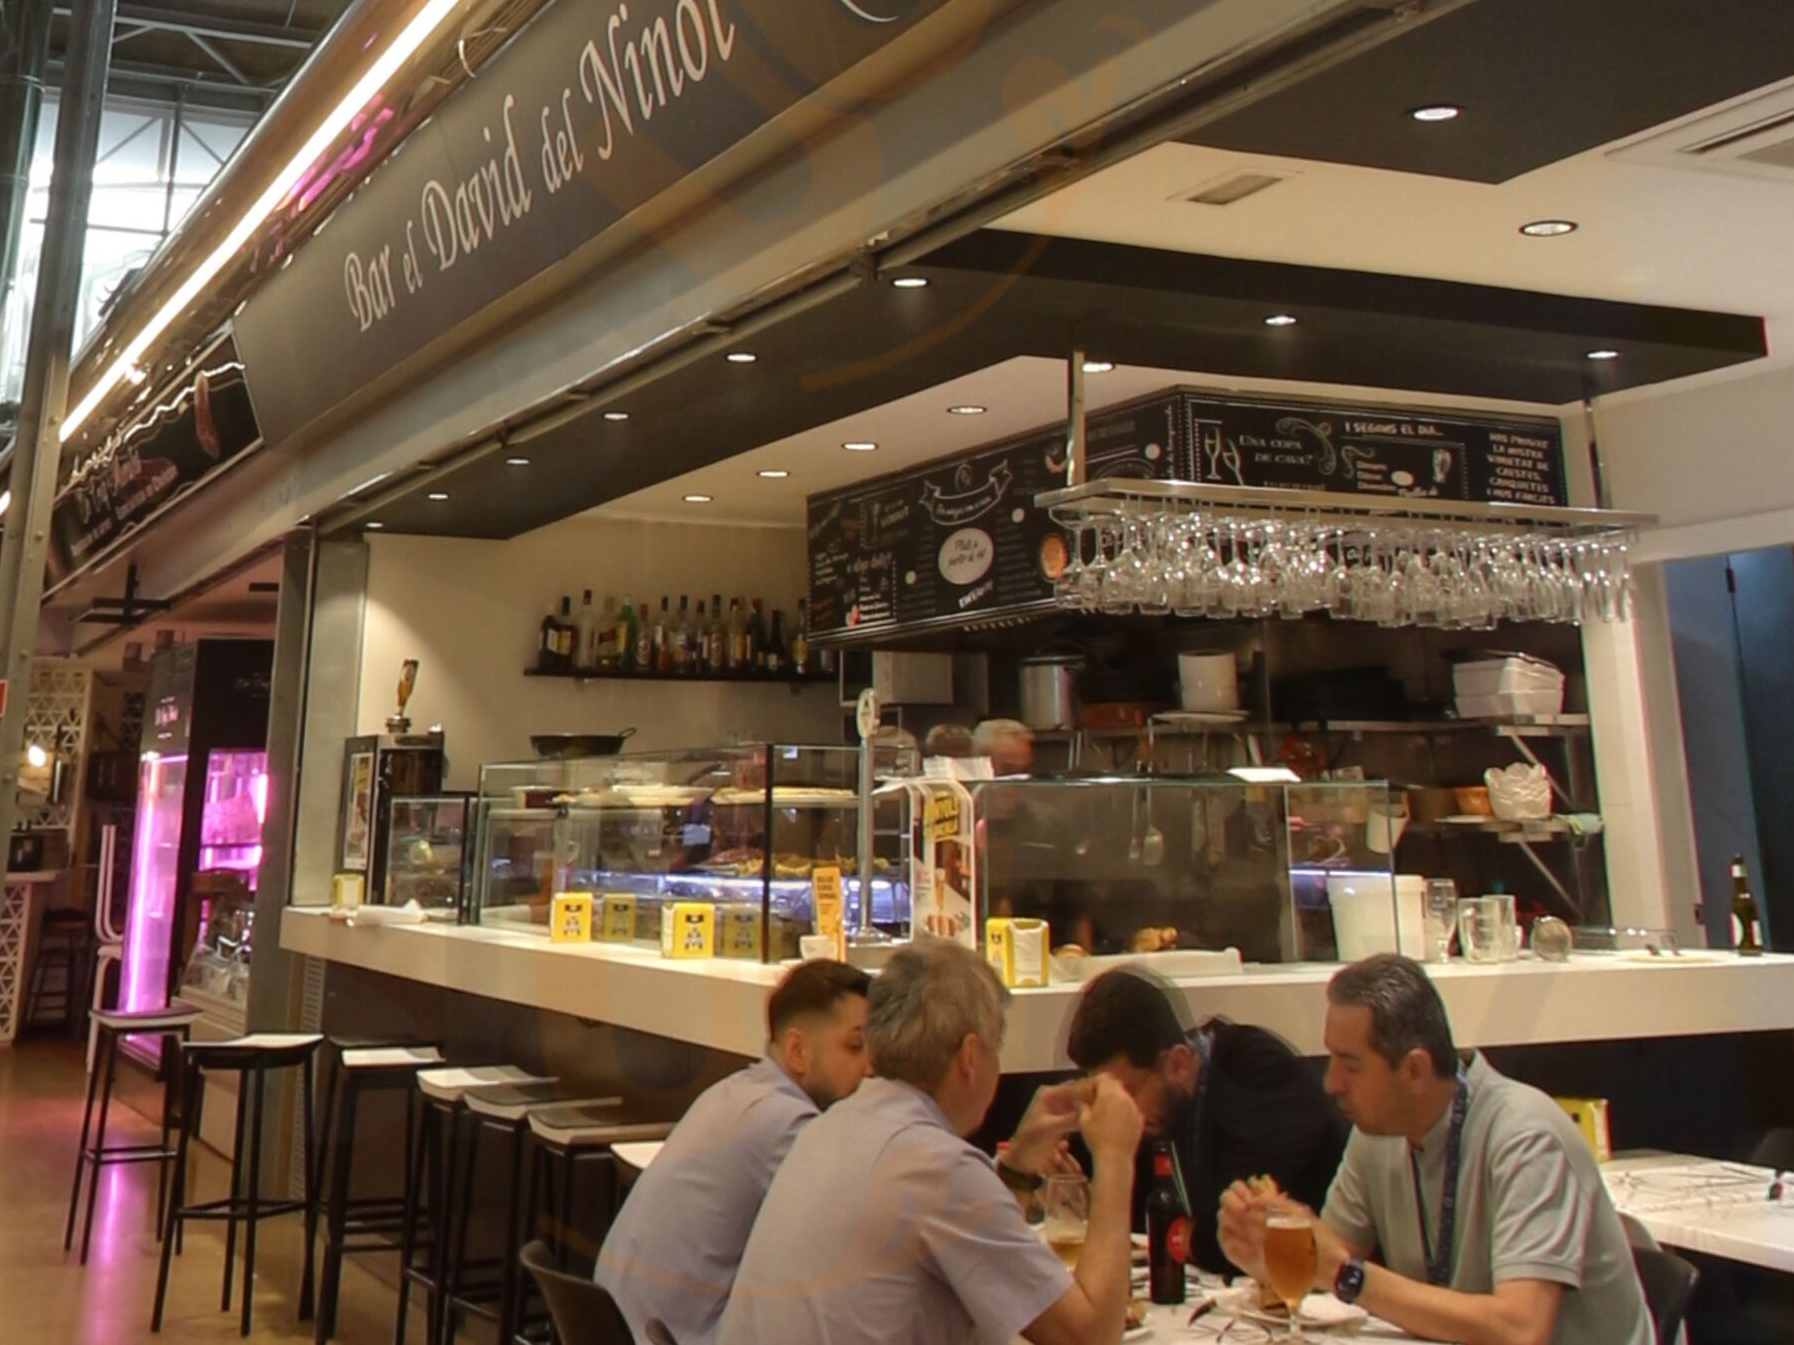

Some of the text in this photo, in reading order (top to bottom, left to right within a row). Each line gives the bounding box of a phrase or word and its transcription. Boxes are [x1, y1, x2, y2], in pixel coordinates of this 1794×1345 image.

[344, 244, 396, 332] Bar
[402, 220, 423, 294] el
[421, 94, 532, 271] David
[541, 87, 584, 194] del
